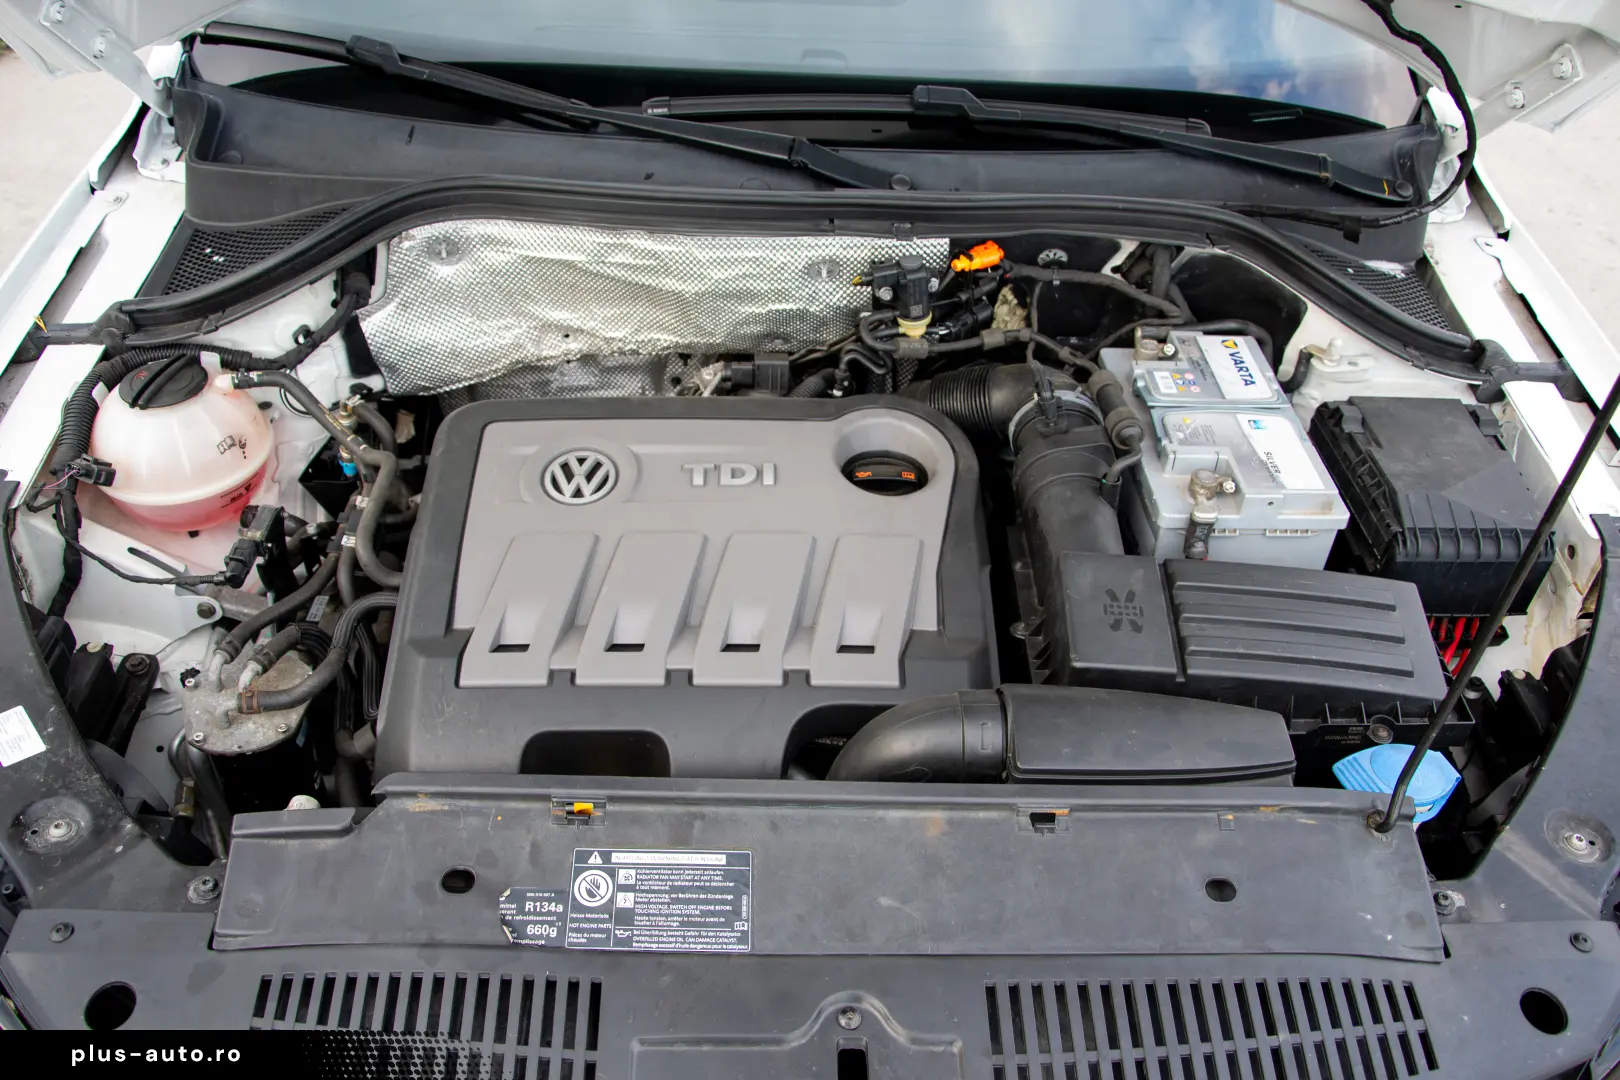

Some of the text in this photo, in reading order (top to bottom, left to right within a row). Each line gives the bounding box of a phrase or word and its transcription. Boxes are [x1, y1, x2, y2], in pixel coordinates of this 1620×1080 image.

[1229, 351, 1256, 387] VARTA
[682, 462, 776, 486] TDI
[1263, 451, 1281, 474] SILVER
[544, 450, 617, 504] VW
[525, 901, 564, 913] R134a
[527, 924, 558, 938] 660g
